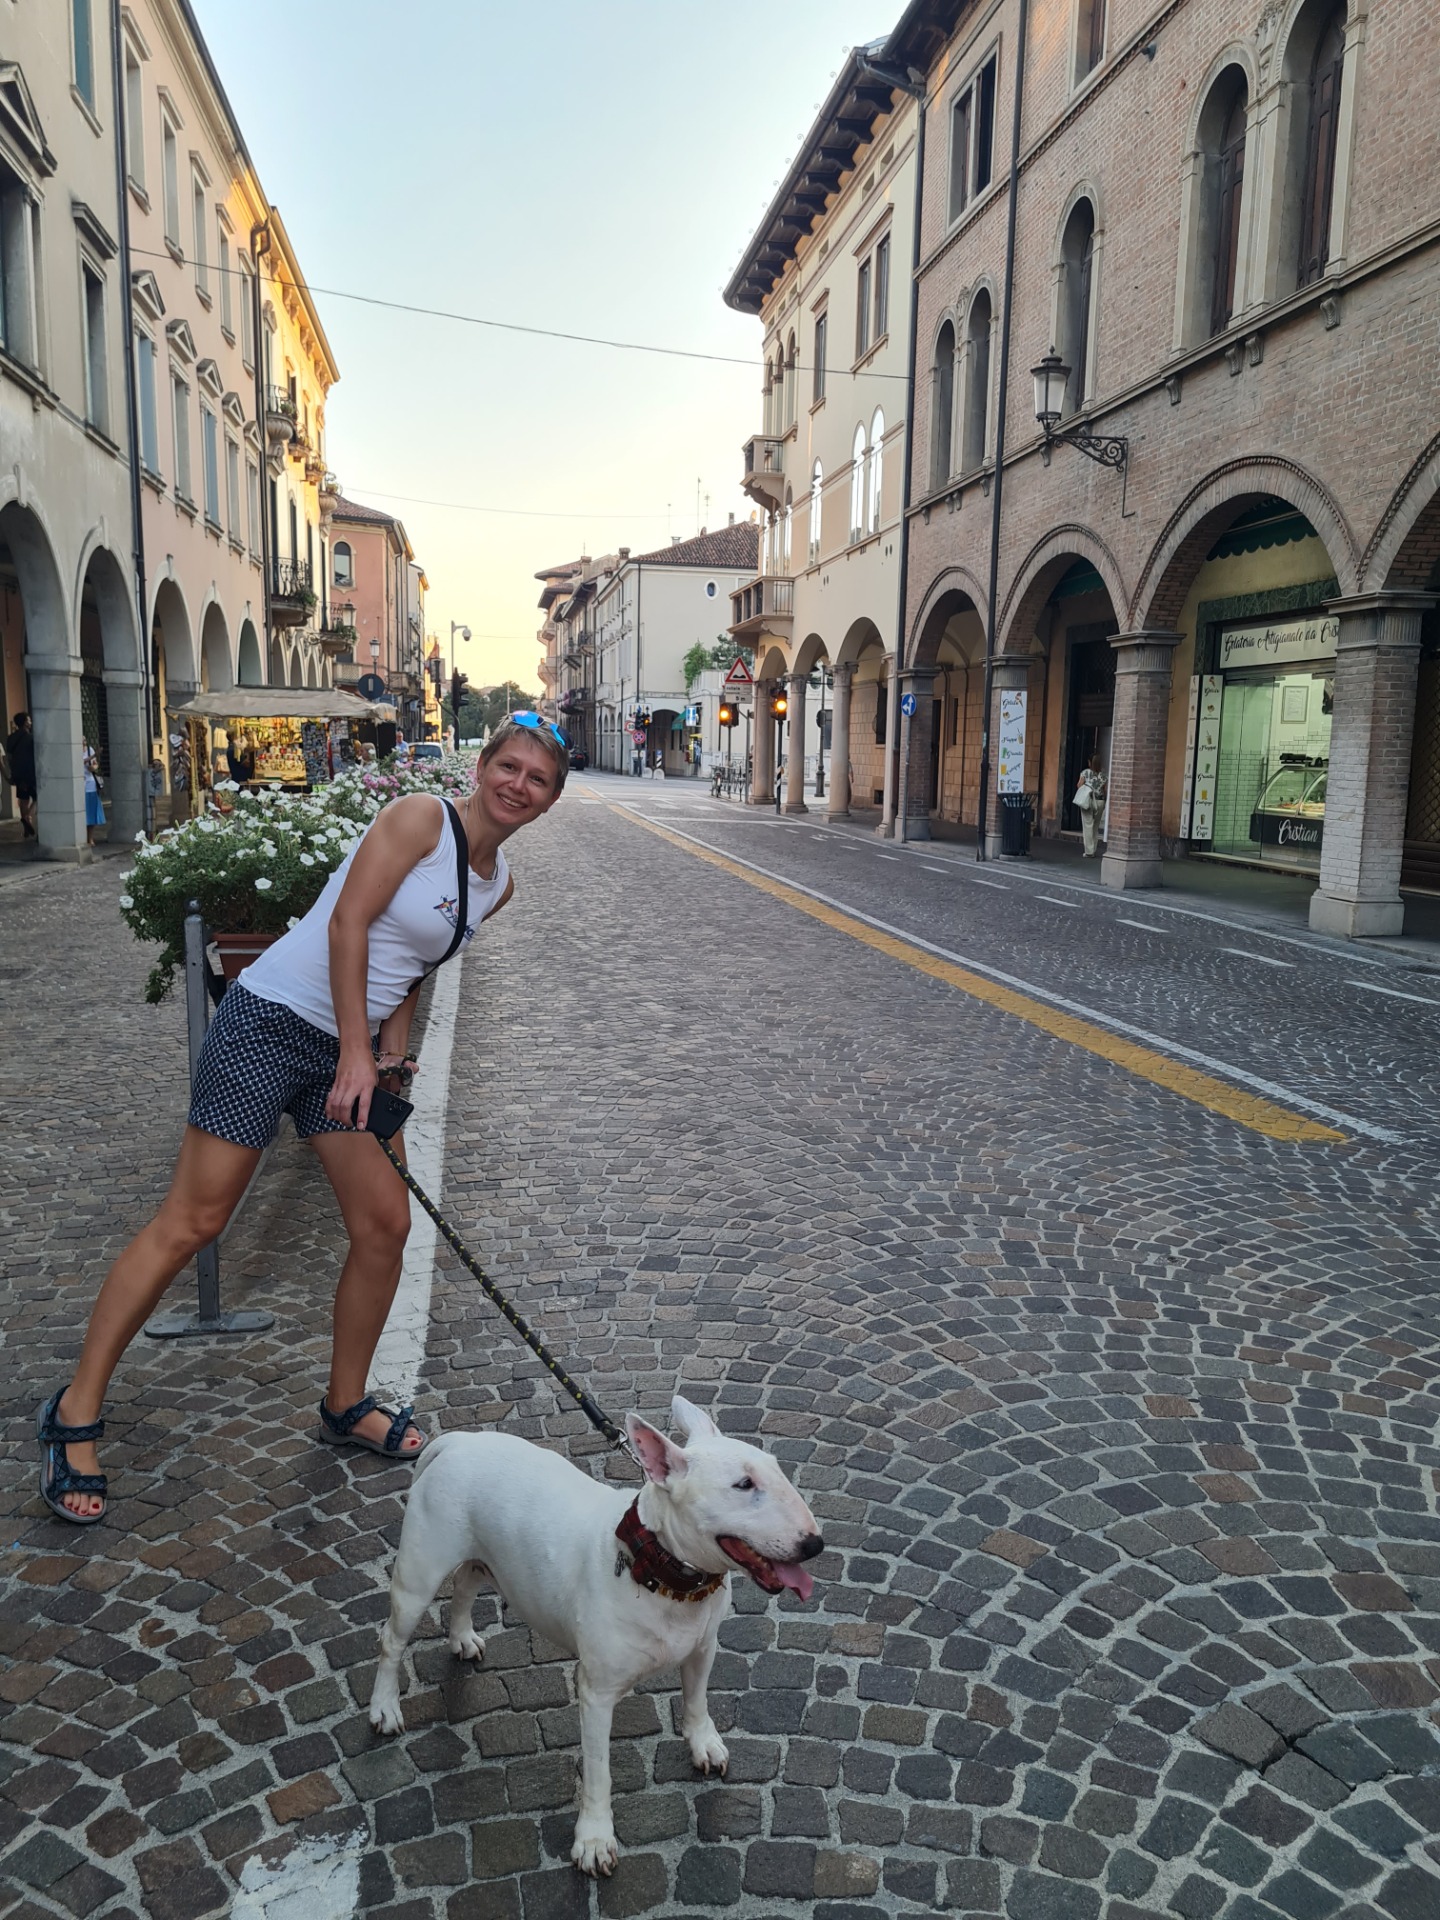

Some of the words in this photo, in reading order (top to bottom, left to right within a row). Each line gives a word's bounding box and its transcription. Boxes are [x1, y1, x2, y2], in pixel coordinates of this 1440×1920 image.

[1225, 634, 1255, 661] Gelateria
[1257, 628, 1303, 653] Artigianale
[1305, 628, 1316, 640] da
[1278, 819, 1318, 845] Cristian
